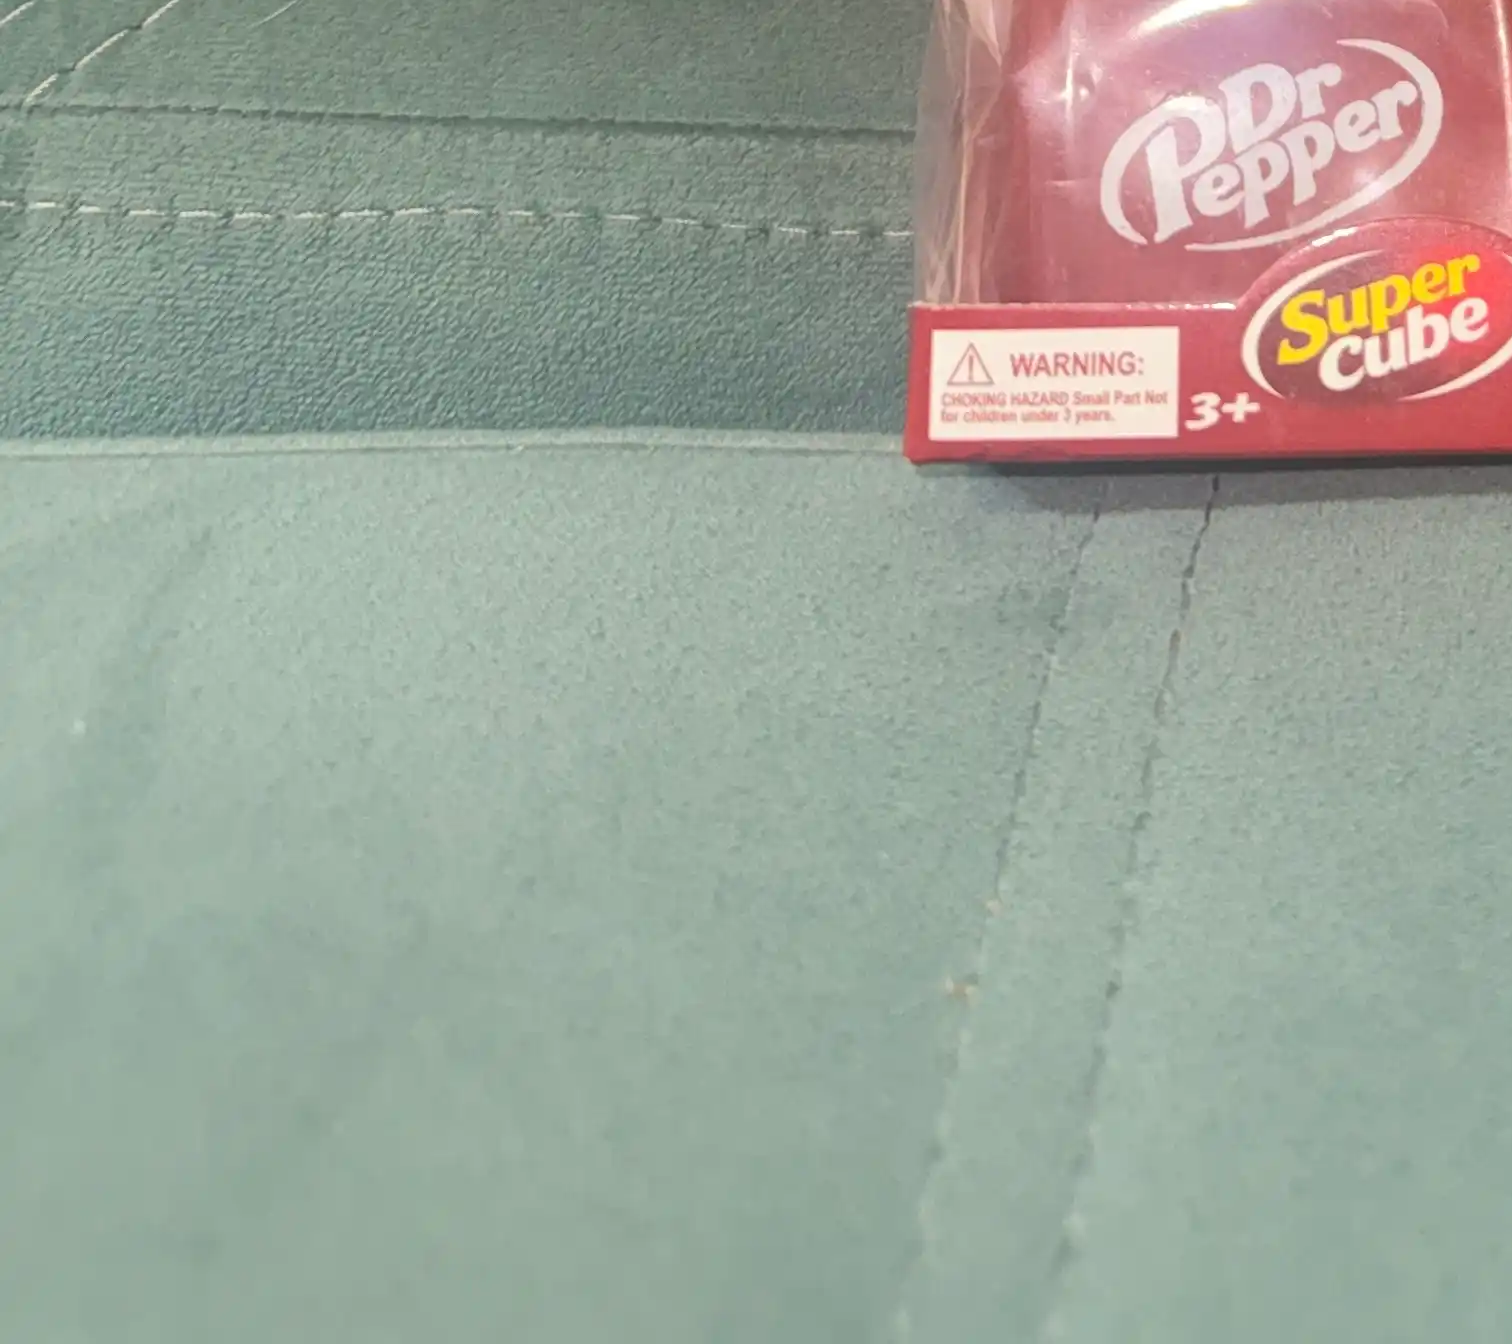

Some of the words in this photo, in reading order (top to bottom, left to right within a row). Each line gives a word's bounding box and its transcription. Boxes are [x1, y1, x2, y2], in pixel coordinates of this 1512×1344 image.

[1218, 62, 1342, 154] Dr
[1145, 79, 1418, 244] Pepper
[1277, 253, 1481, 366] Super
[1009, 350, 1145, 378] WARNING:
[1318, 296, 1490, 392] Cube
[941, 391, 1006, 407] CHOKING
[1011, 390, 1069, 406] HAZARD
[1072, 390, 1110, 405] Small
[1114, 389, 1141, 405] Part
[1145, 389, 1168, 404] Not
[941, 408, 958, 423] for
[963, 408, 1017, 424] children
[1021, 408, 1059, 423] under
[1063, 408, 1072, 422] 3
[1184, 391, 1261, 431] 3+
